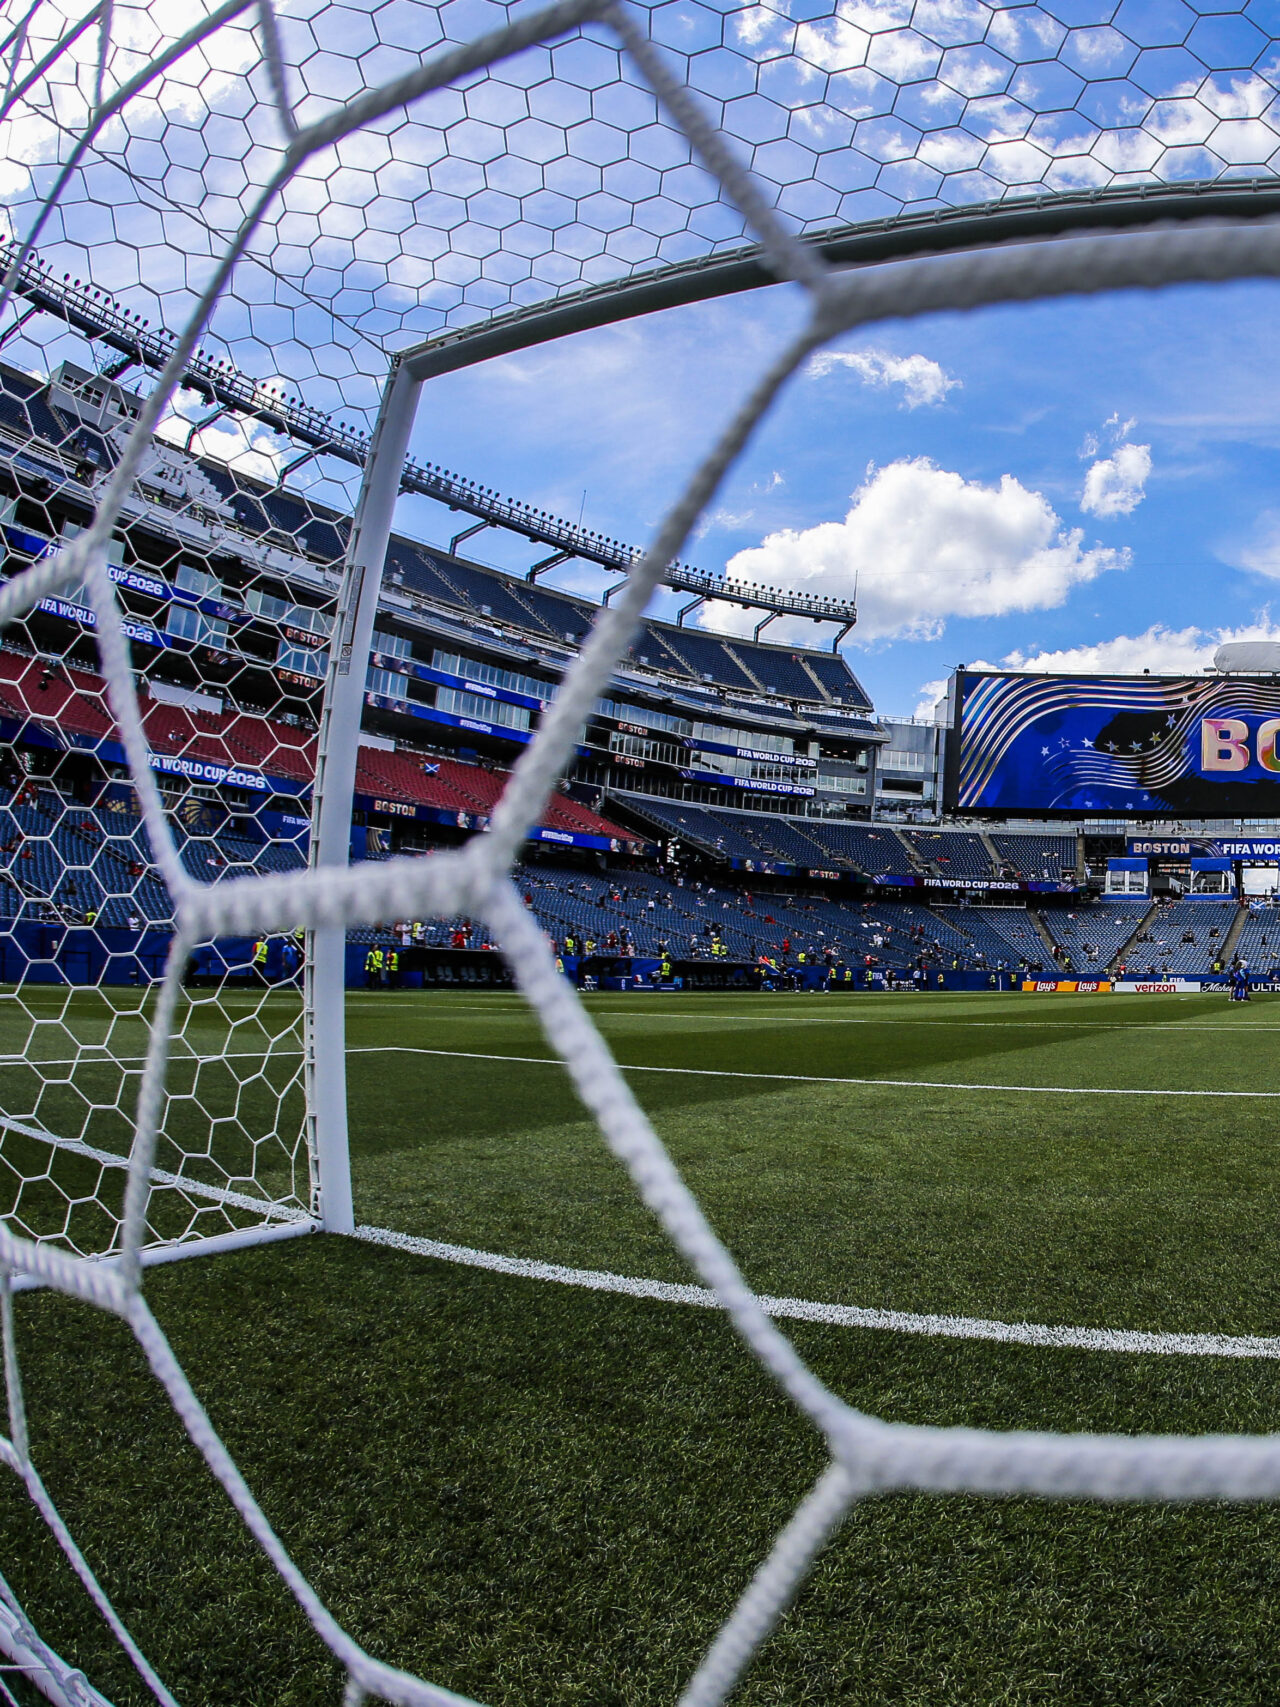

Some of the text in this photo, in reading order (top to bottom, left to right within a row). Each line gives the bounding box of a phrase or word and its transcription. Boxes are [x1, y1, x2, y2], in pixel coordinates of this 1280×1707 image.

[107, 567, 128, 583] CUP
[128, 574, 164, 596] 2026
[40, 599, 154, 643] IFA WORLD 2026
[618, 722, 648, 736] BOSTON
[736, 748, 753, 759] FIFA
[752, 750, 780, 763] WORLD
[780, 754, 795, 765] CUP
[162, 757, 203, 777] WORLD
[204, 766, 227, 781] CUP
[226, 771, 267, 790] 2026
[734, 777, 750, 788] FIFA
[749, 780, 777, 792] WORLD
[777, 783, 793, 794] CUP
[373, 800, 416, 817] BOSTON
[1133, 842, 1190, 854] BOSTON
[1222, 843, 1251, 855] FIFA
[924, 878, 1020, 890] FIFA WORLD CUP 2026
[1036, 981, 1057, 992] Lay's
[1078, 981, 1098, 992] Lay's
[1135, 982, 1177, 993] verizon
